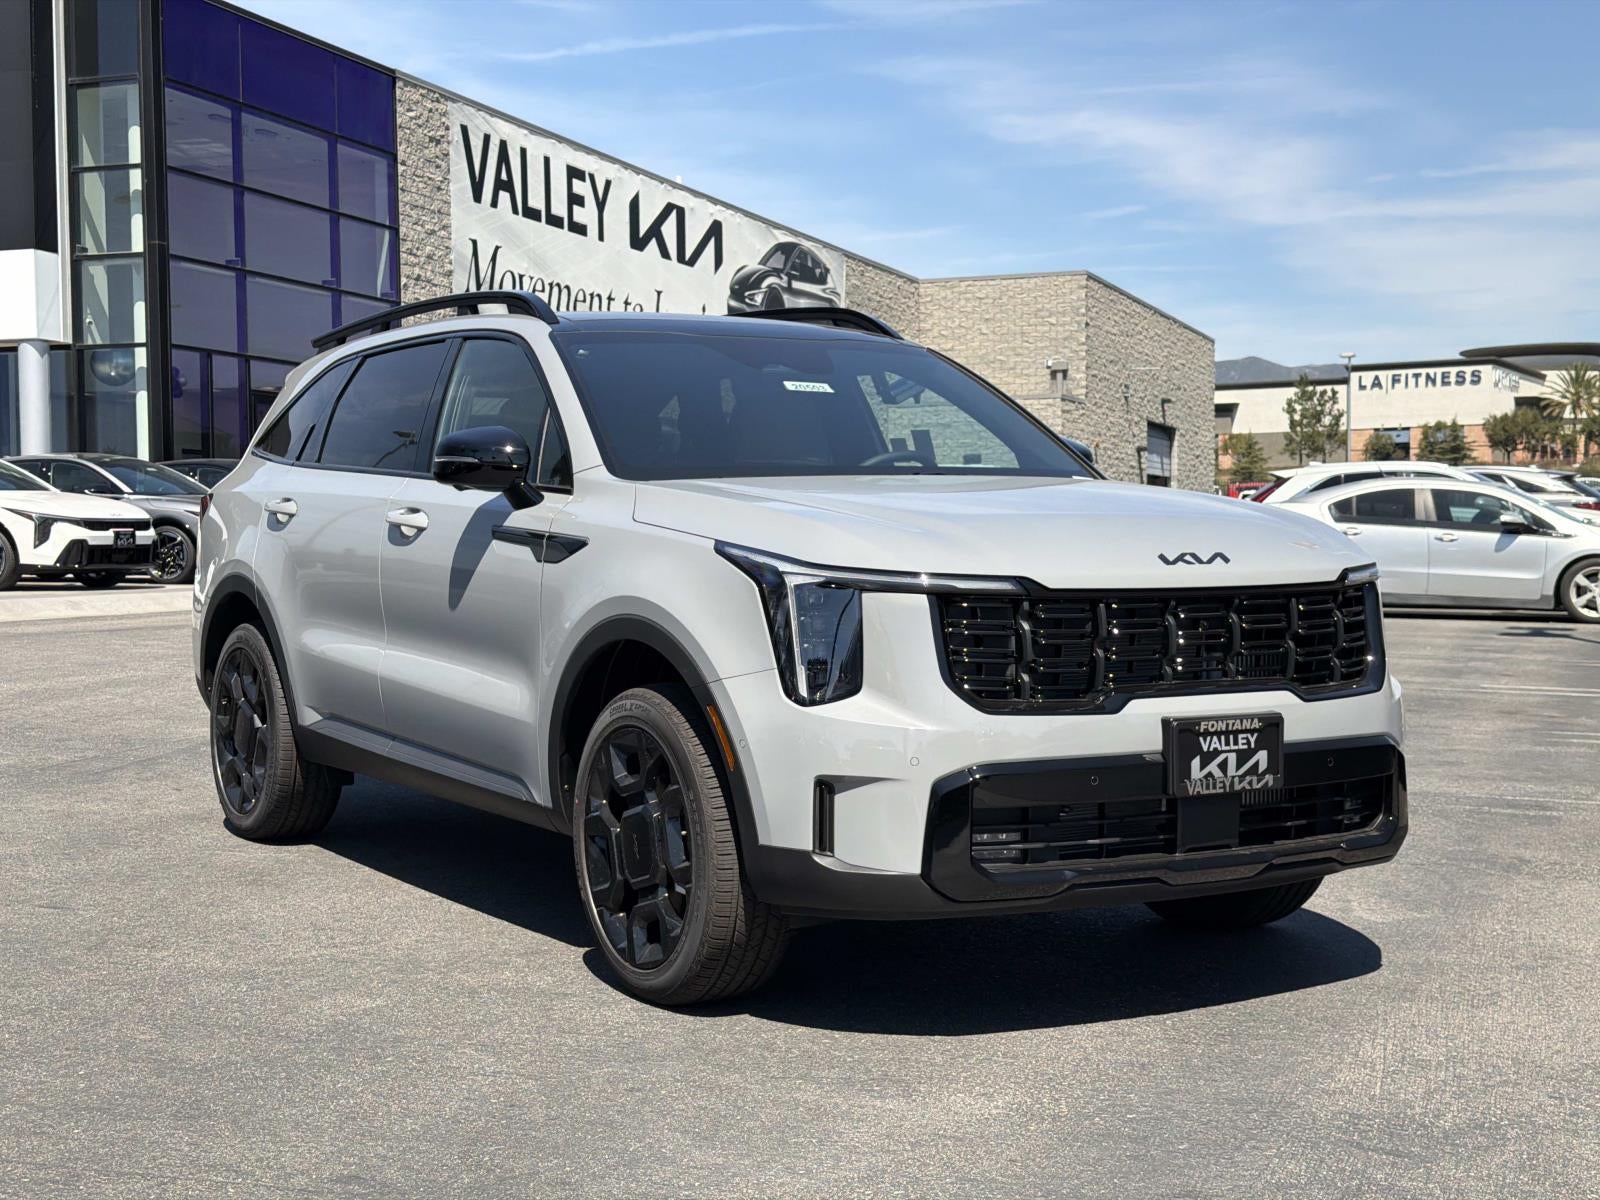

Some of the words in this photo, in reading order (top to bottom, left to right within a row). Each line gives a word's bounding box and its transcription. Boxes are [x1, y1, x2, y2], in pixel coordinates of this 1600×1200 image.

[460, 124, 612, 242] VALLEY
[629, 189, 723, 275] KIA
[1391, 369, 1482, 390] FITNESS
[1157, 551, 1231, 566] KIA
[1200, 718, 1260, 733] FONTANA
[1199, 733, 1258, 752] VALLEY
[1184, 776, 1232, 796] VALLEY
